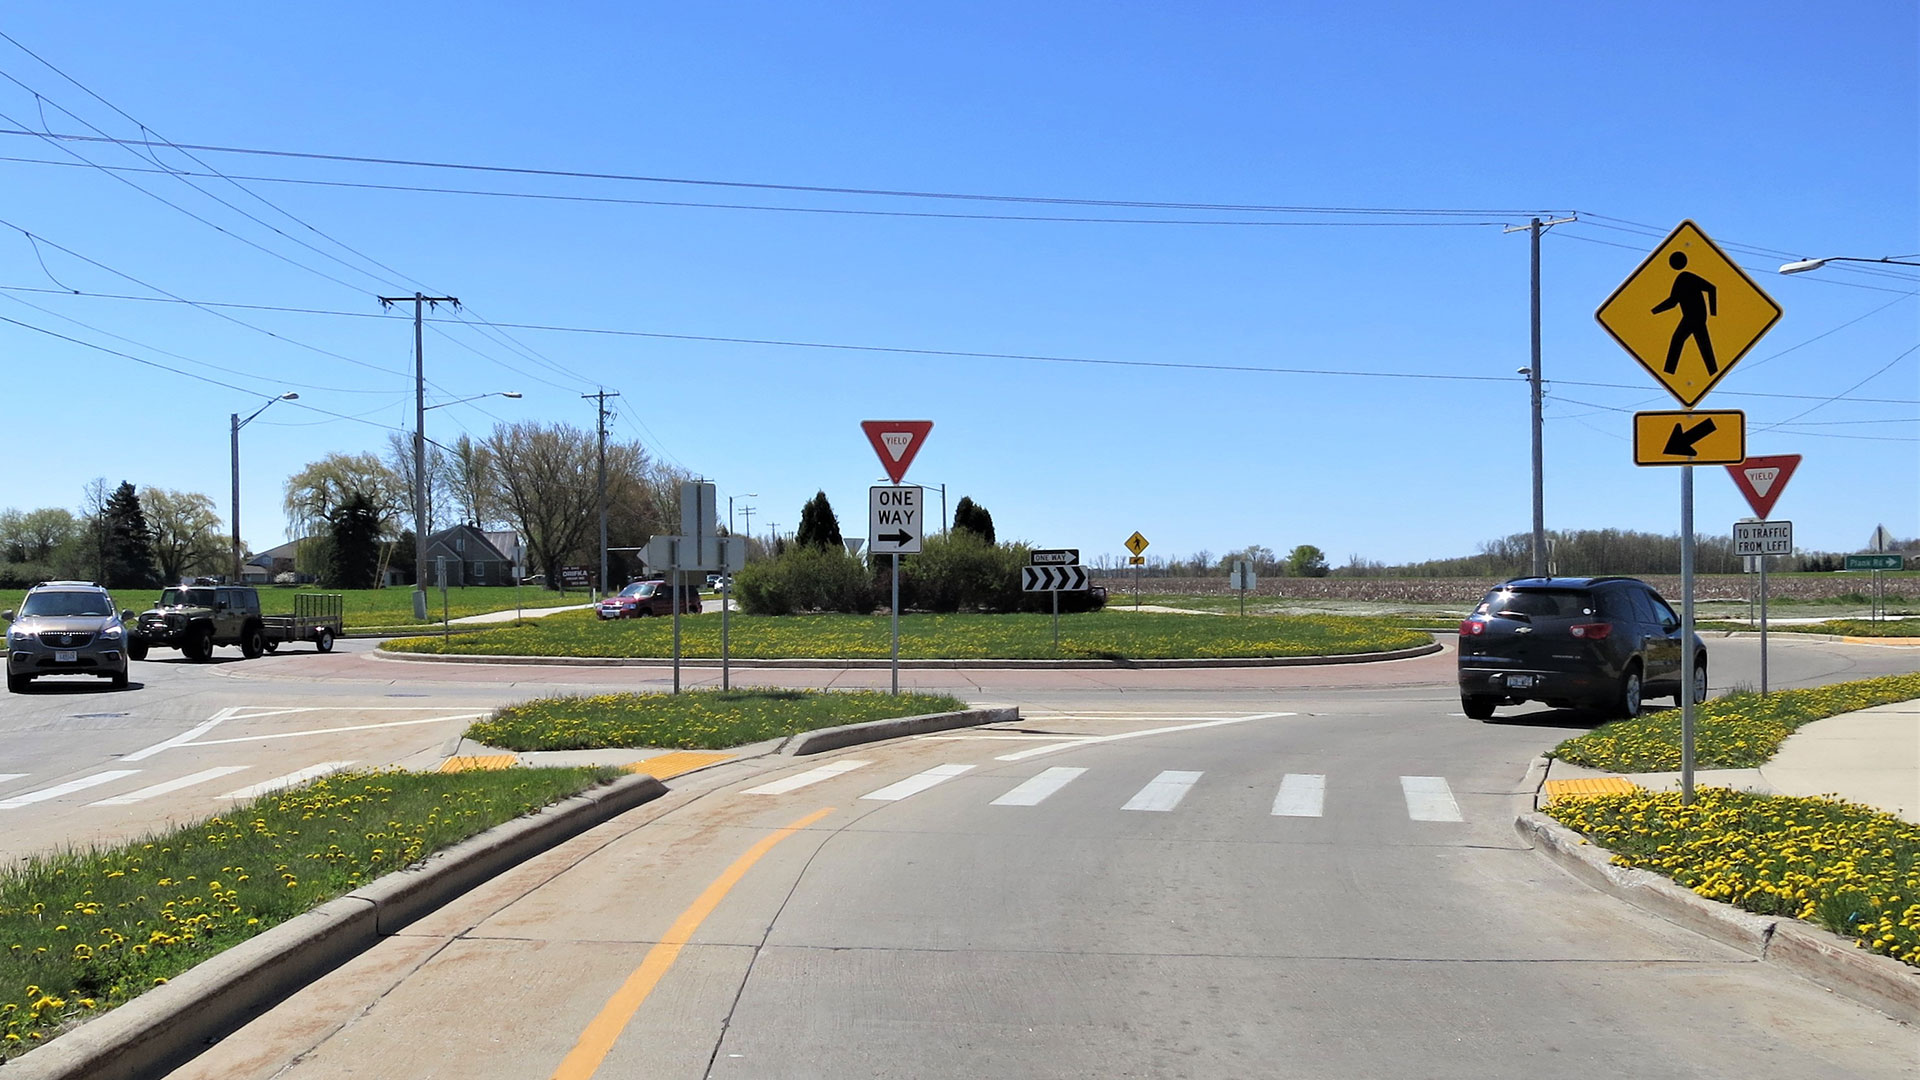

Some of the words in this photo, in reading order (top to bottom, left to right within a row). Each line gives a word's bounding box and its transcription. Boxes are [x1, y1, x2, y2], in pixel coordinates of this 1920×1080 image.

[886, 437, 908, 445] YIELD
[1750, 472, 1774, 481] YIELD
[879, 491, 913, 506] ONE
[878, 510, 914, 525] WAY
[1739, 529, 1749, 539] TO
[1752, 527, 1788, 538] TRAFFIC
[1738, 541, 1762, 552] FROM
[1766, 540, 1787, 551] LEFT
